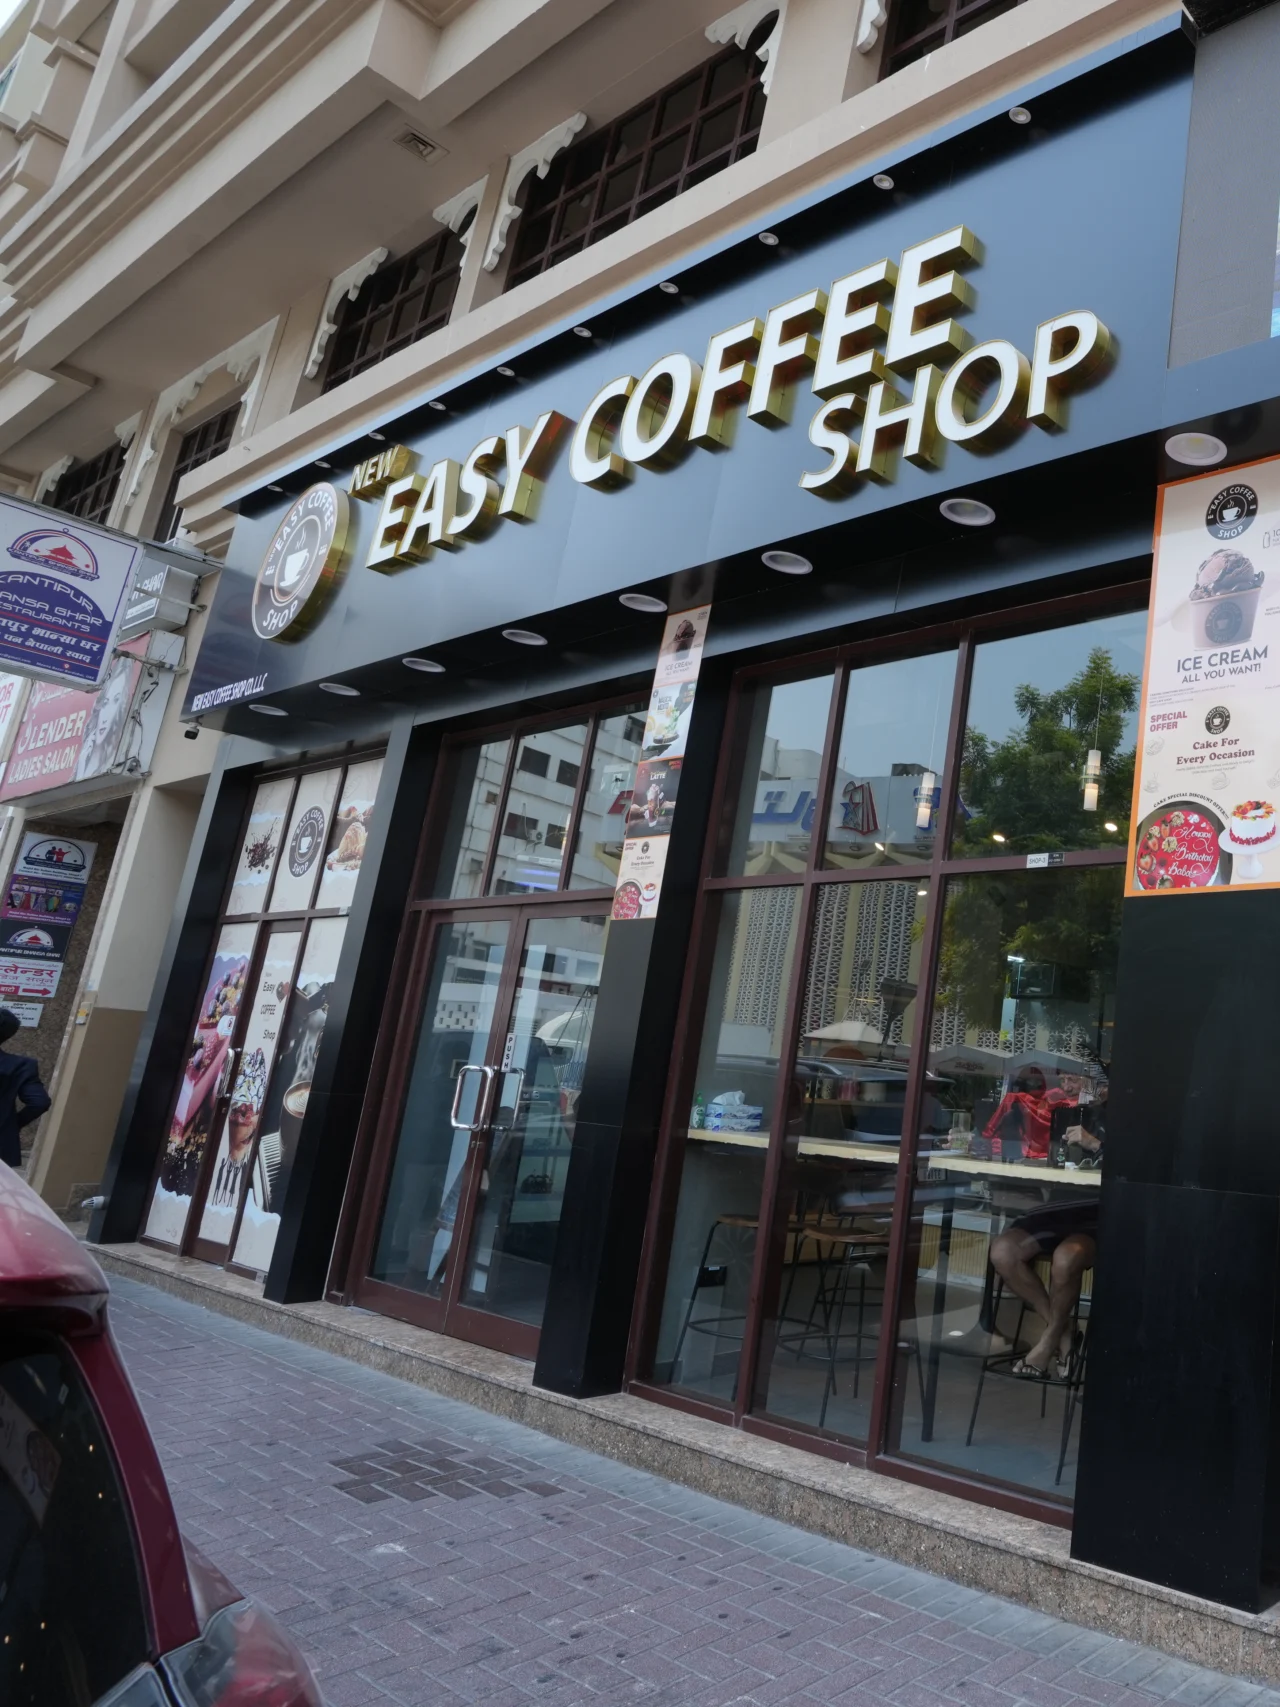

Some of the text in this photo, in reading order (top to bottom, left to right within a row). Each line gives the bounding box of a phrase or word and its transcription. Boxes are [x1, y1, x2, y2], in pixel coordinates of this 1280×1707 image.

[365, 224, 980, 572] EASY COFFEE
[799, 310, 1112, 492] SHOP
[350, 446, 404, 496] NEW
[1211, 486, 1255, 510] EASY COFFEE
[275, 491, 334, 551] EASY COFFEE
[1217, 525, 1244, 538] SHOP
[55, 606, 103, 627] GHAR
[263, 599, 298, 631] SHOP
[1177, 645, 1269, 673] ICE CREAM
[1181, 662, 1261, 684] ALL YOU WANT!
[214, 684, 233, 705] COFFEE
[231, 680, 247, 700] SHOP
[1150, 711, 1188, 723] SPECIAL
[1150, 721, 1178, 732] OFFER
[1193, 738, 1240, 750] Cake For
[8, 744, 79, 784] LADIES SALON
[1176, 755, 1206, 766] Every
[1209, 749, 1255, 761] Occasion
[1153, 797, 1167, 808] CAKE
[1167, 793, 1188, 801] SPECIAL
[1188, 792, 1213, 804] DISCOUNT
[310, 809, 324, 831] COFFEE
[1172, 842, 1213, 864] Birthday
[292, 861, 309, 875] SHOP
[263, 982, 276, 994] Easy
[263, 1029, 275, 1042] Shop
[504, 1036, 513, 1068] PUSH
